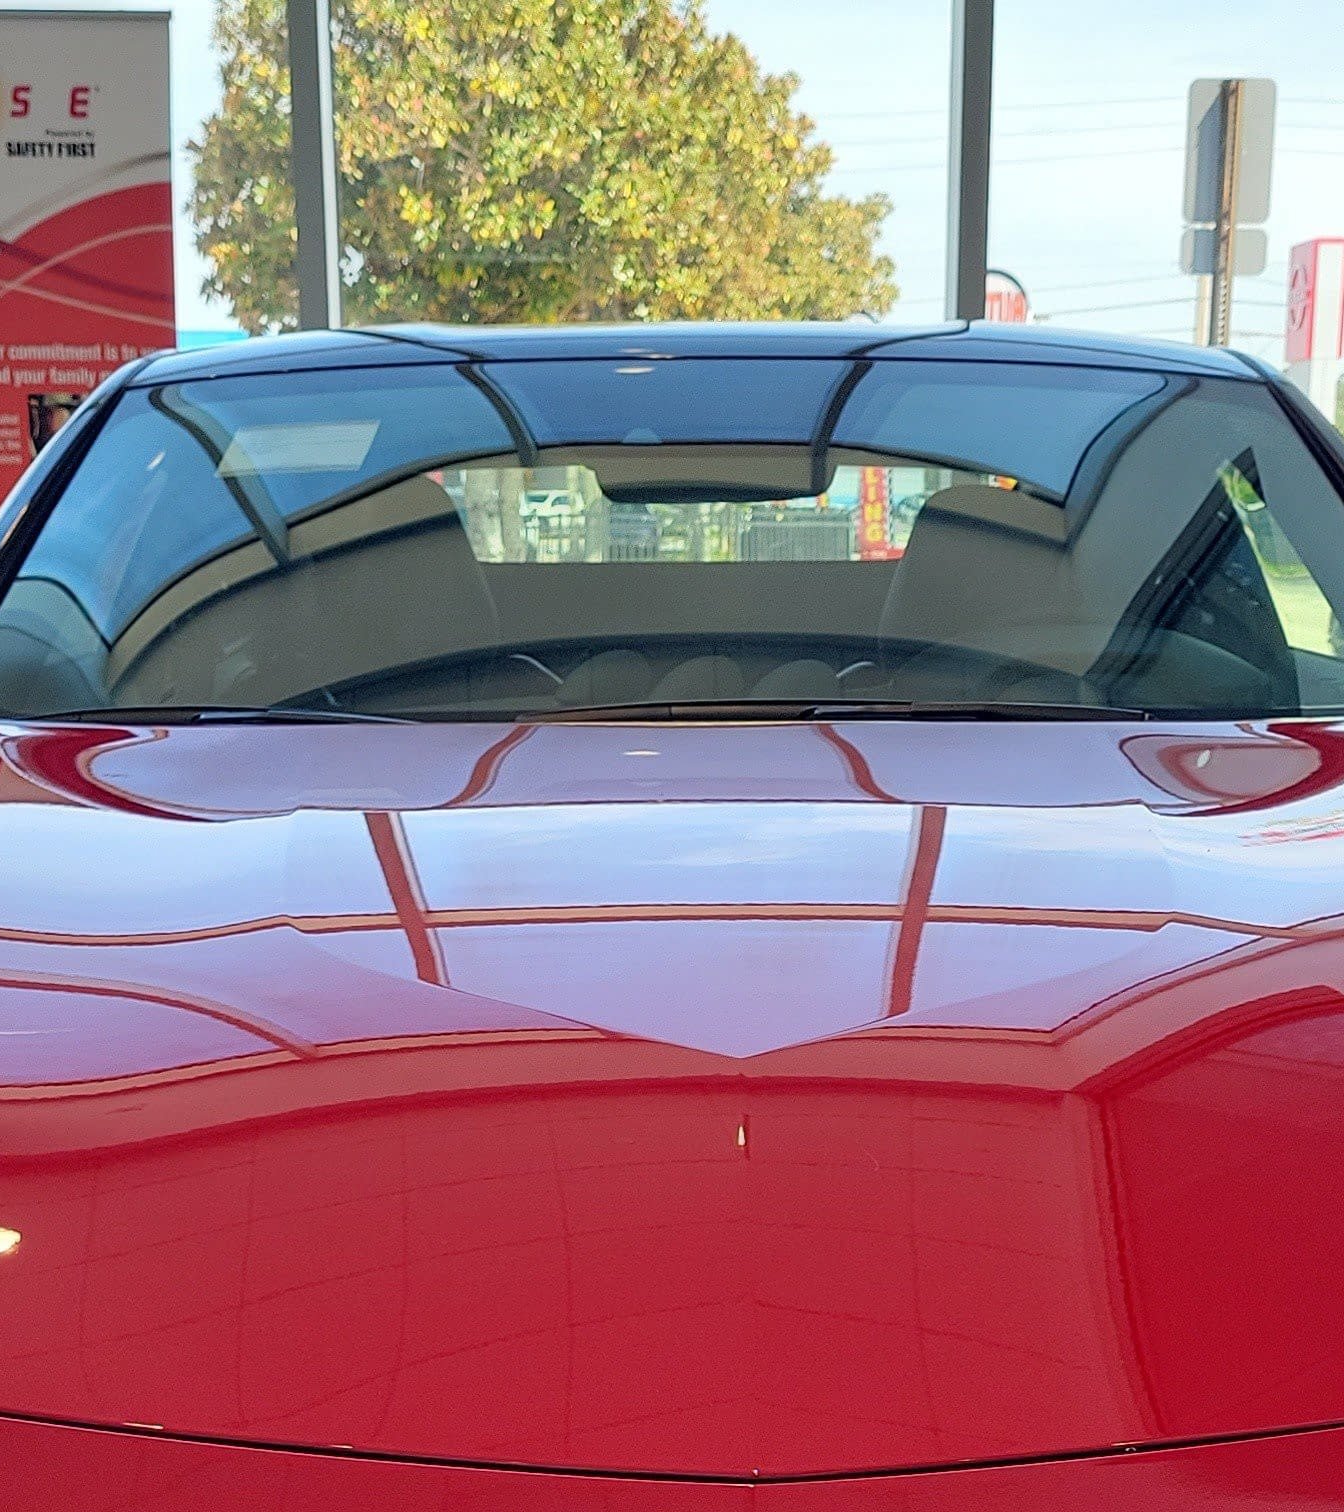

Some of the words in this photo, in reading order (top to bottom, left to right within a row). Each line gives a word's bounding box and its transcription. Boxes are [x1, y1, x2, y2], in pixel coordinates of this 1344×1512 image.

[57, 141, 95, 157] FIRST
[7, 343, 101, 362] commitment
[105, 344, 118, 361] is
[13, 369, 46, 388] your
[50, 366, 96, 387] family
